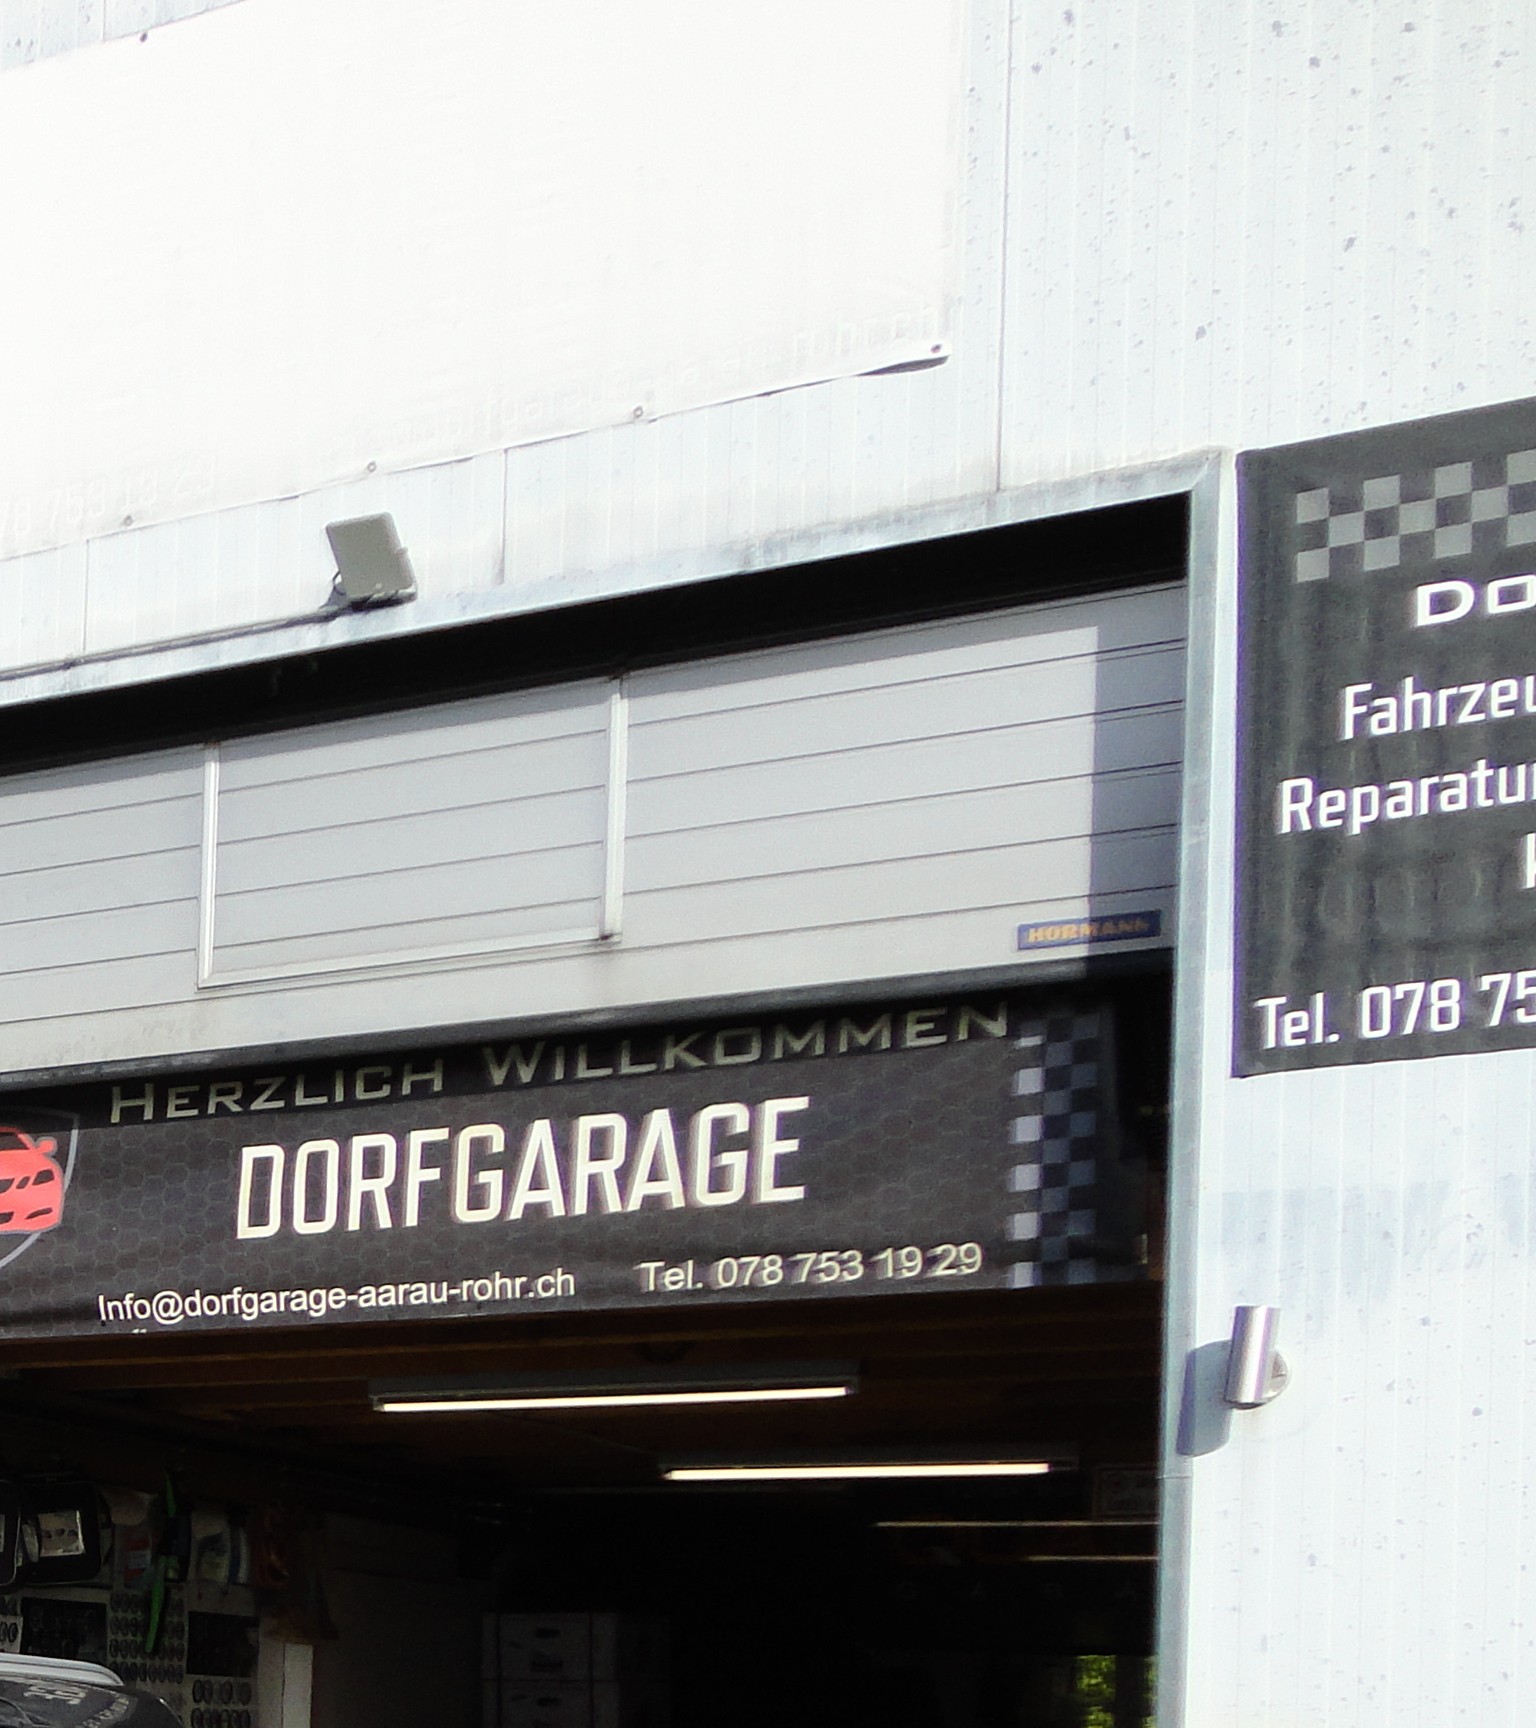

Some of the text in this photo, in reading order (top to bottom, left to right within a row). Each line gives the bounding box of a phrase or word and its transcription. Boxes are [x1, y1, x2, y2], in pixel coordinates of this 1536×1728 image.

[1276, 757, 1536, 836] Reparatu
[1253, 991, 1341, 1050] Tel.
[1359, 978, 1462, 1040] 078
[110, 1001, 1010, 1123] HERZLICH WILLKOMMEN
[235, 1095, 810, 1241] DORFGARAGE
[97, 1241, 984, 1324] Info@dorfgarage-aarau-rohr.ch Tel. 078 753 19 29
